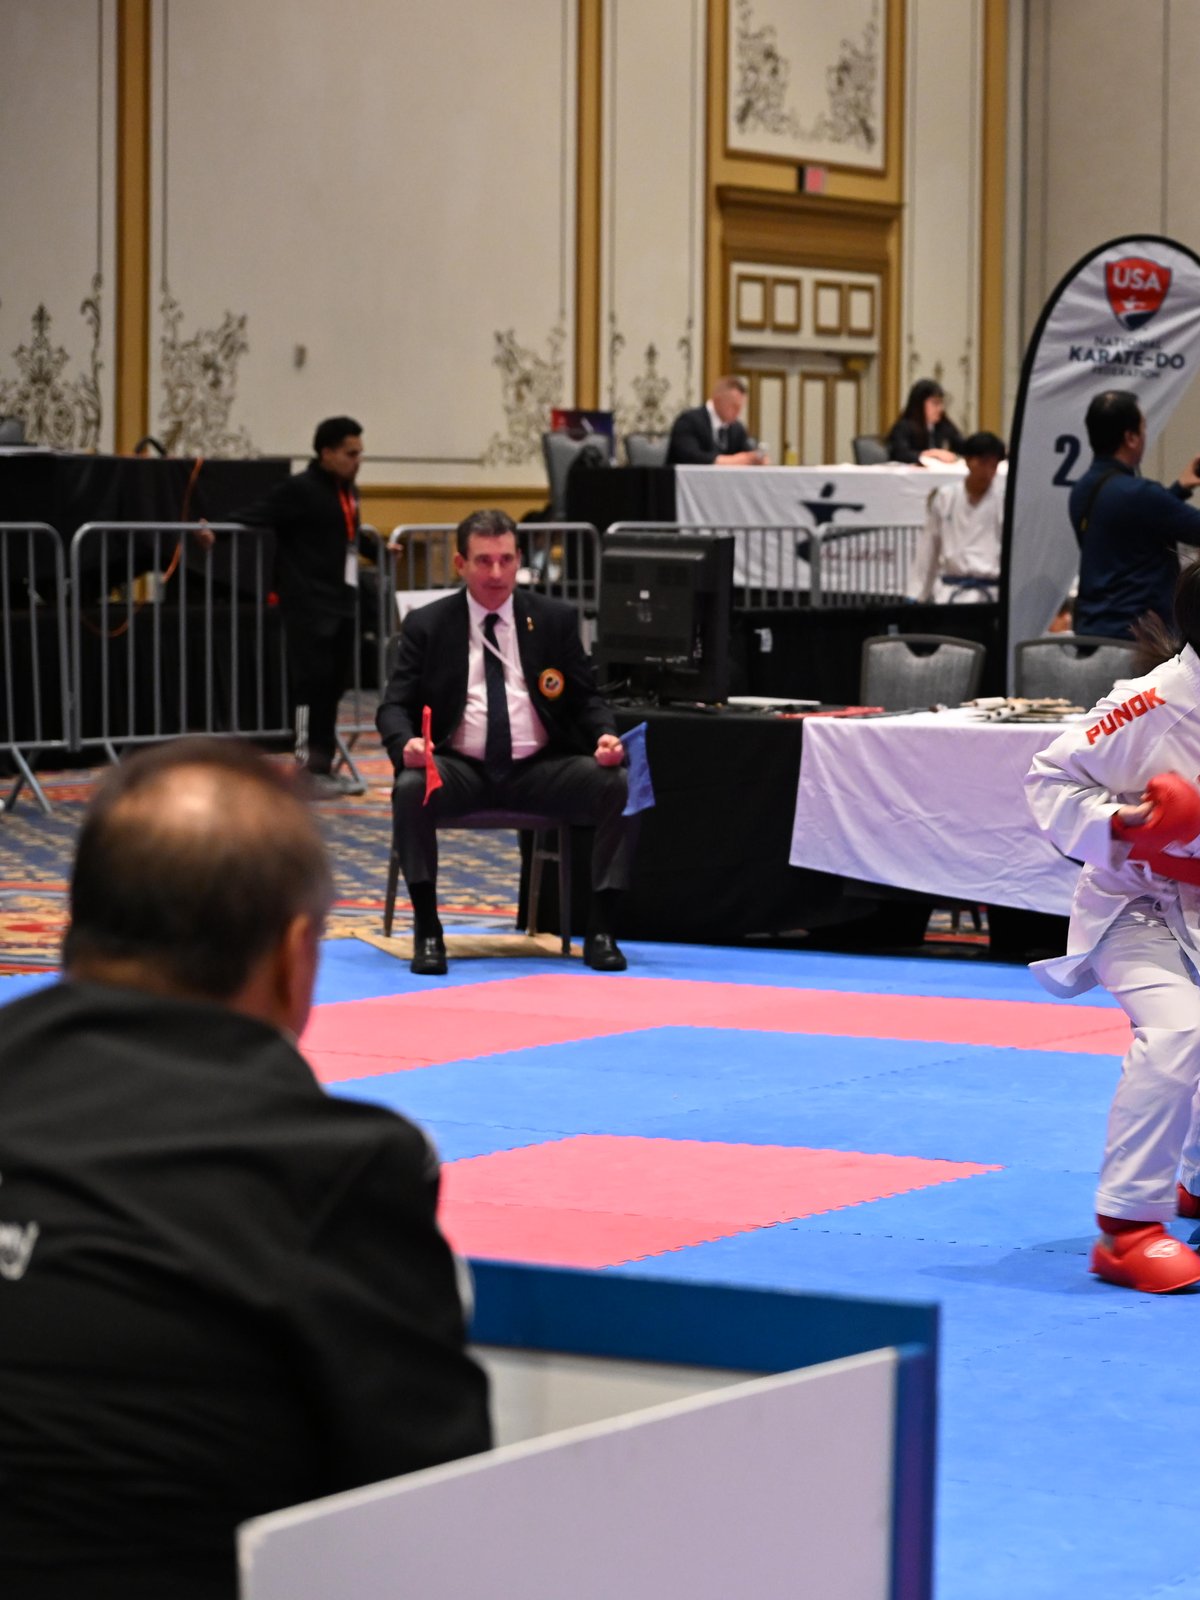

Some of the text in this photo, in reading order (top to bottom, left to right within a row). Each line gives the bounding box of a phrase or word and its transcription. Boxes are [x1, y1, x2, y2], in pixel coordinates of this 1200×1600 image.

[1112, 266, 1161, 292] USA
[1069, 345, 1186, 370] KARATE-DO
[1086, 686, 1167, 746] PUNOK
